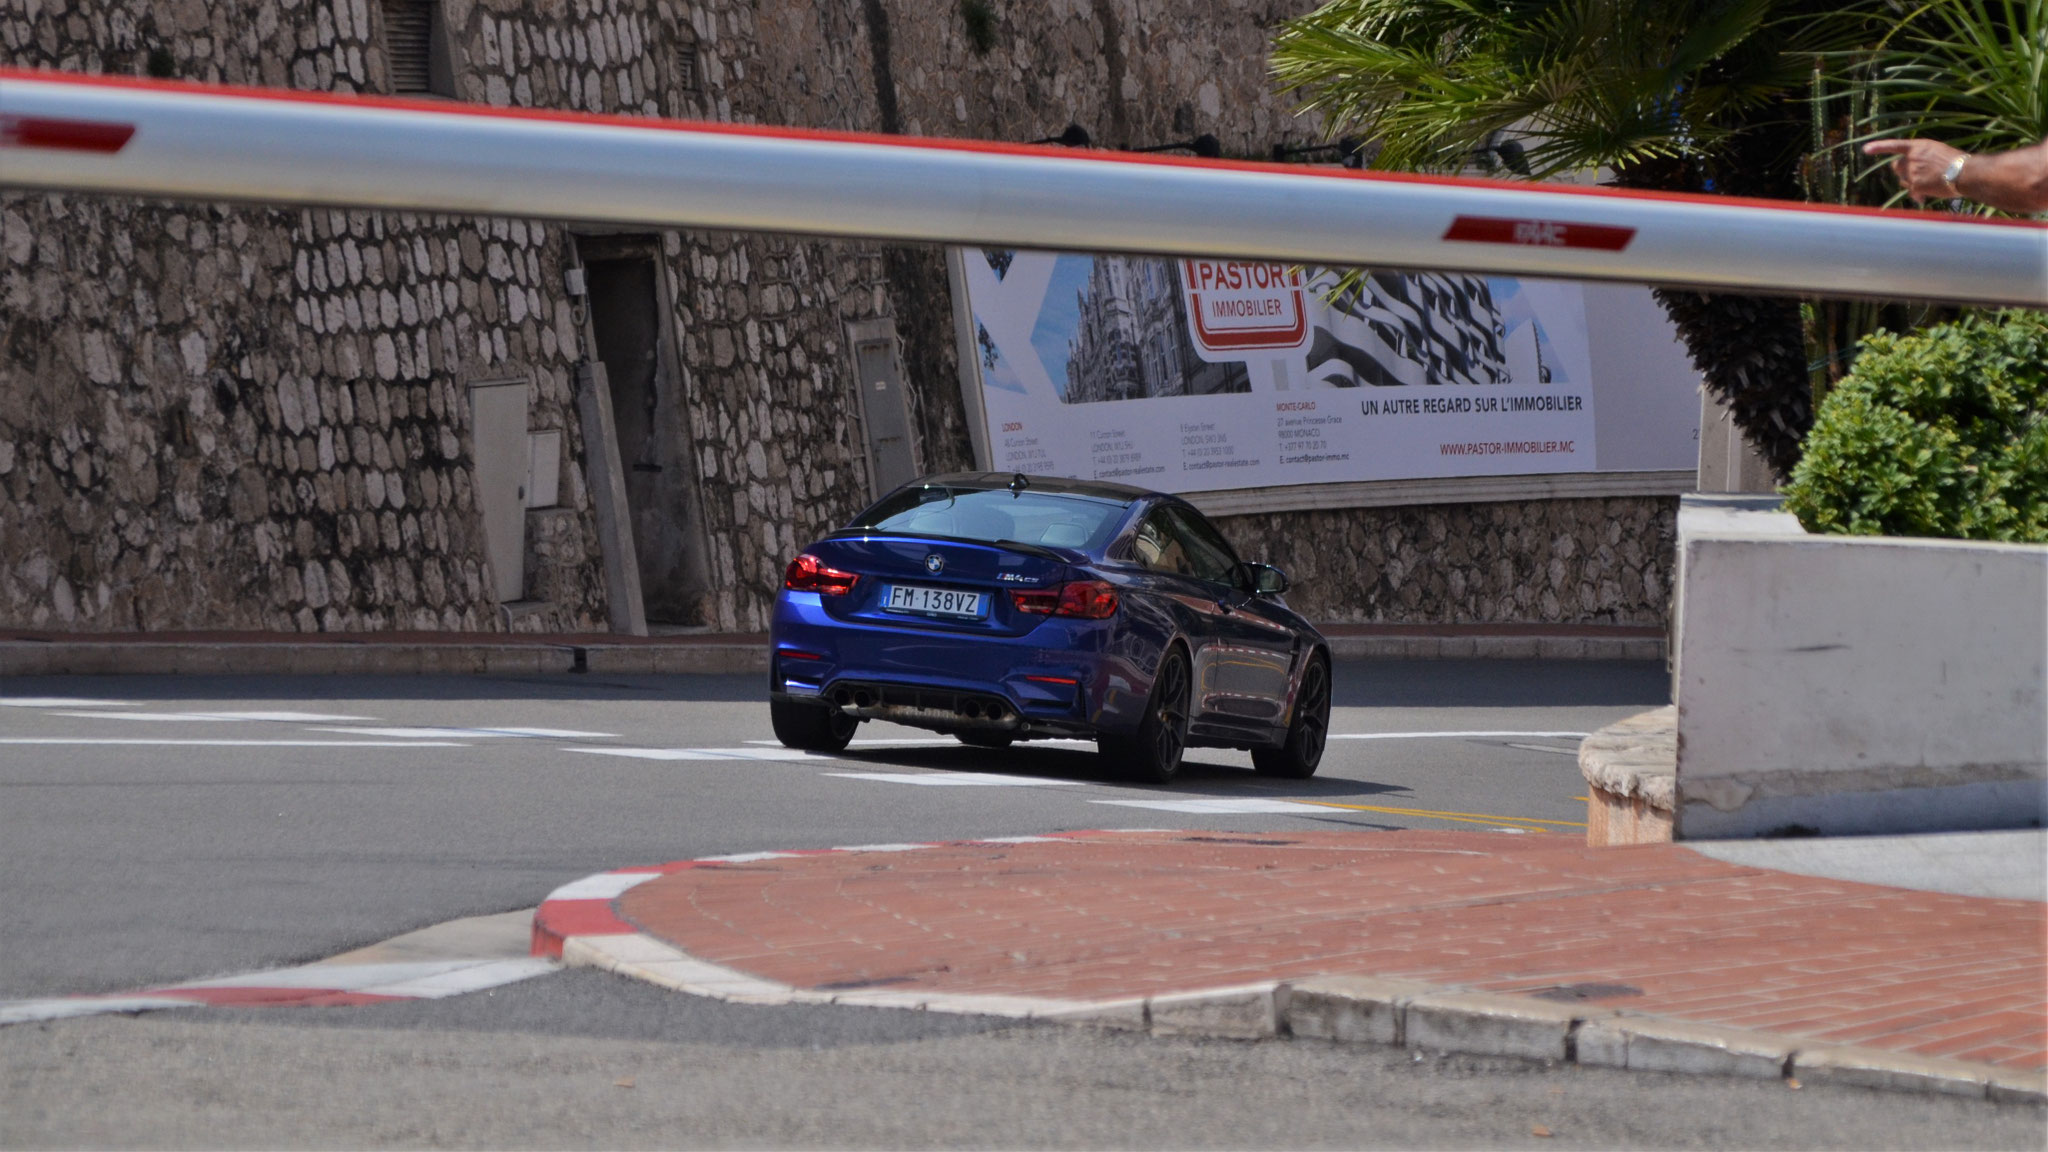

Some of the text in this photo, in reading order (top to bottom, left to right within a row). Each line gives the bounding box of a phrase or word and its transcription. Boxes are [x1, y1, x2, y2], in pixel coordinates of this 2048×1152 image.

[1199, 261, 1286, 290] PASTOR
[1212, 299, 1282, 317] IMMOBILIER
[1276, 401, 1316, 411] MONTE-CARLO
[1361, 396, 1583, 416] UN AUTRE REGARD SUR L'IMMOBILIER
[1303, 416, 1326, 425] Princesse
[1327, 415, 1342, 424] Grace
[1294, 428, 1320, 438] MONACO
[1439, 441, 1575, 456] WWW.PASTOR-IMMOBILIER.MC
[892, 587, 914, 607] FM
[923, 590, 977, 613] 138VZ
